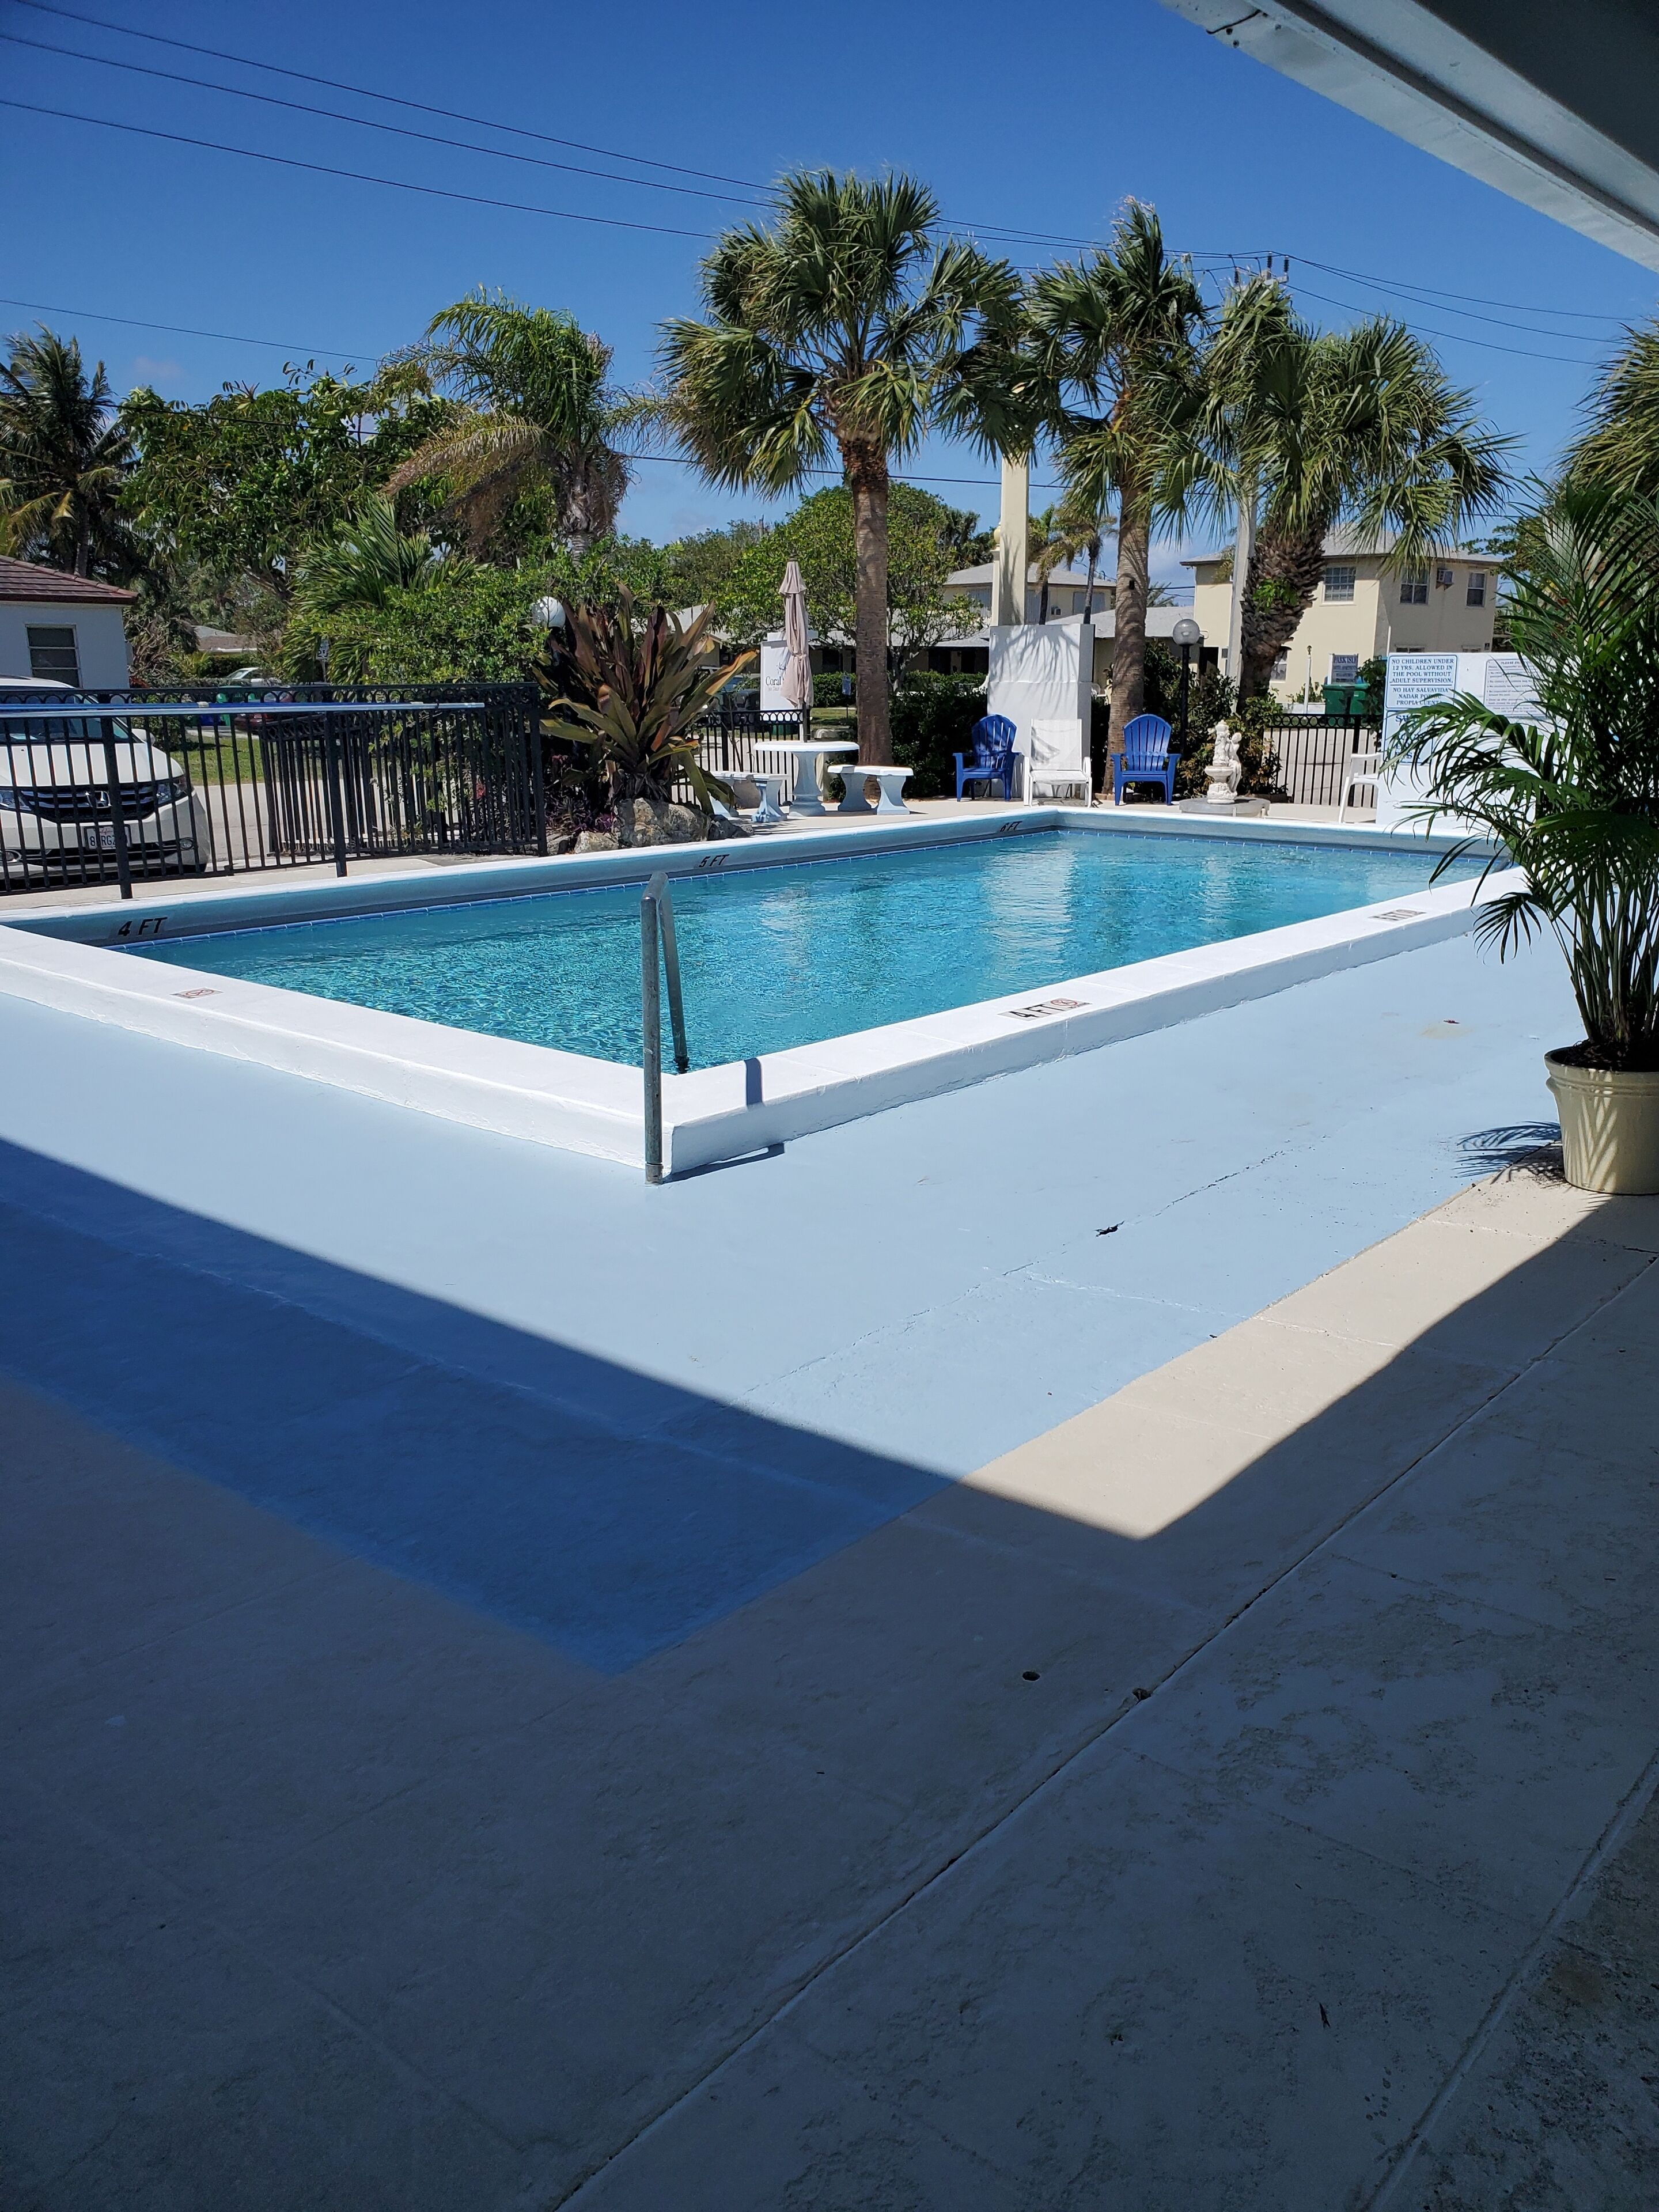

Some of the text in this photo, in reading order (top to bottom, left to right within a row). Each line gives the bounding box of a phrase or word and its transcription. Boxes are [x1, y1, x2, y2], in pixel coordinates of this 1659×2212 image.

[766, 676, 781, 685] Coral
[1007, 821, 1022, 831] FT
[699, 854, 730, 868] 5 FT
[118, 916, 168, 937] 4 FT
[1022, 1004, 1065, 1015] FT
